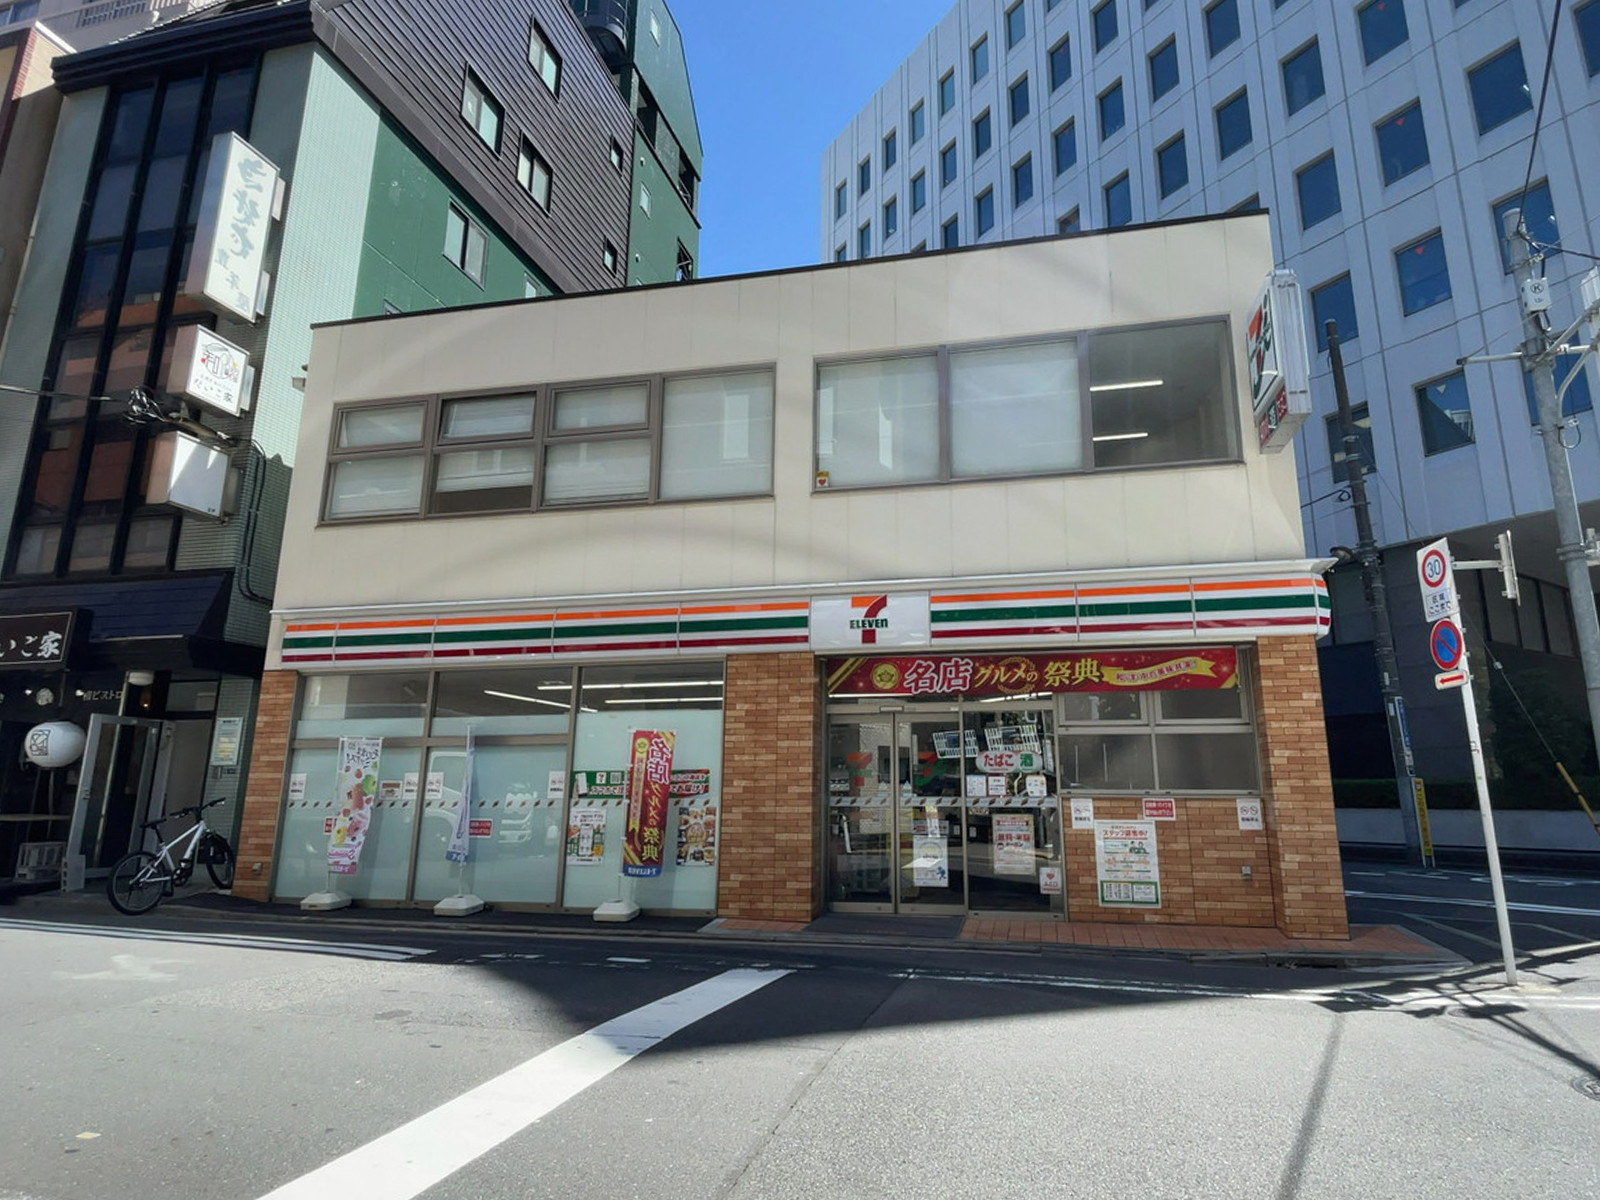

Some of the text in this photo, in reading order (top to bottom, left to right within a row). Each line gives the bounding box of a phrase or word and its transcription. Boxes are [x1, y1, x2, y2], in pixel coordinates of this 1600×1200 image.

[1427, 559, 1441, 578] 30
[984, 754, 1014, 767] たばこ
